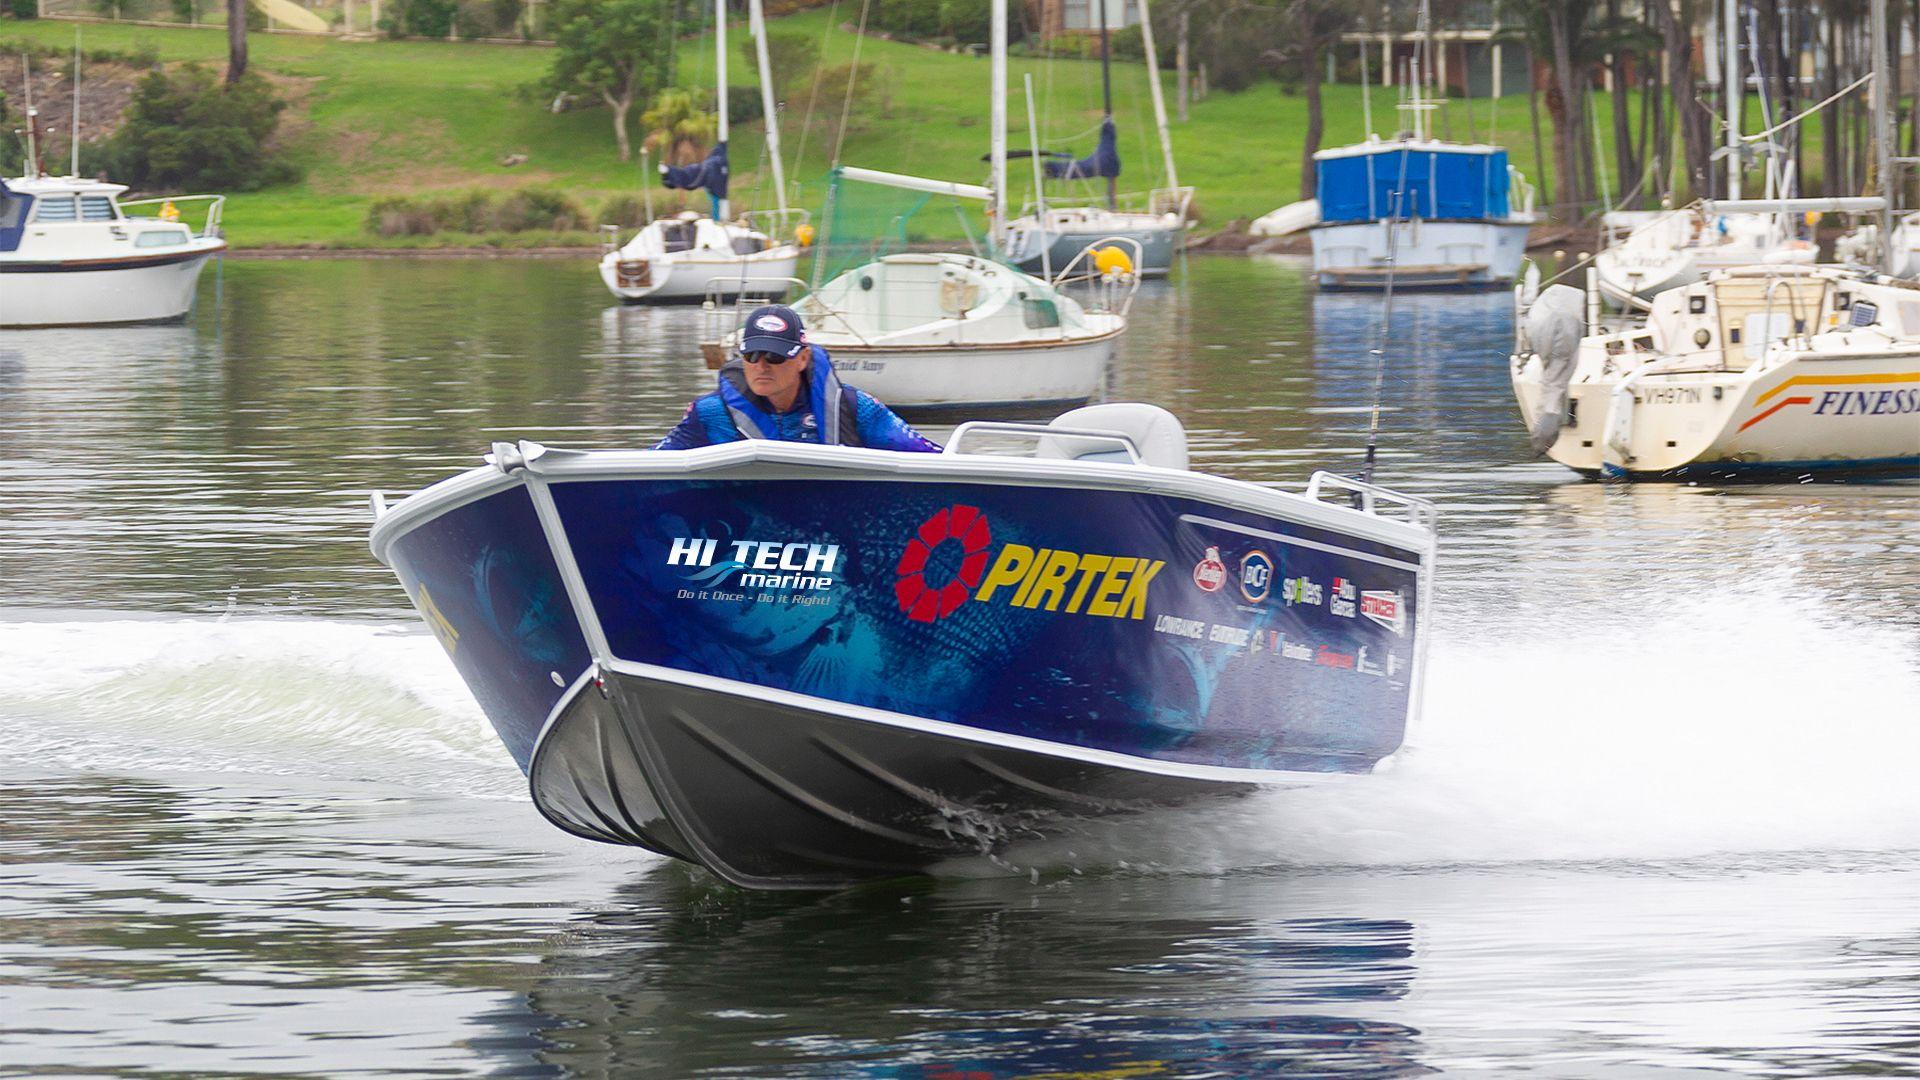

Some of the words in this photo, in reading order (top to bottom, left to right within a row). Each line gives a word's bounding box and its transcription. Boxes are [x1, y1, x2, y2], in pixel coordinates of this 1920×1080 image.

[1813, 388, 1920, 415] FINESS
[667, 537, 718, 566] HI
[731, 540, 839, 572] TECH
[739, 572, 833, 591] marine
[975, 543, 1166, 620] PIRTEK
[677, 589, 694, 599] Do
[698, 590, 708, 600] it
[712, 591, 744, 602] Once
[757, 593, 774, 603] Do
[777, 594, 789, 604] it
[792, 594, 831, 607] Right!
